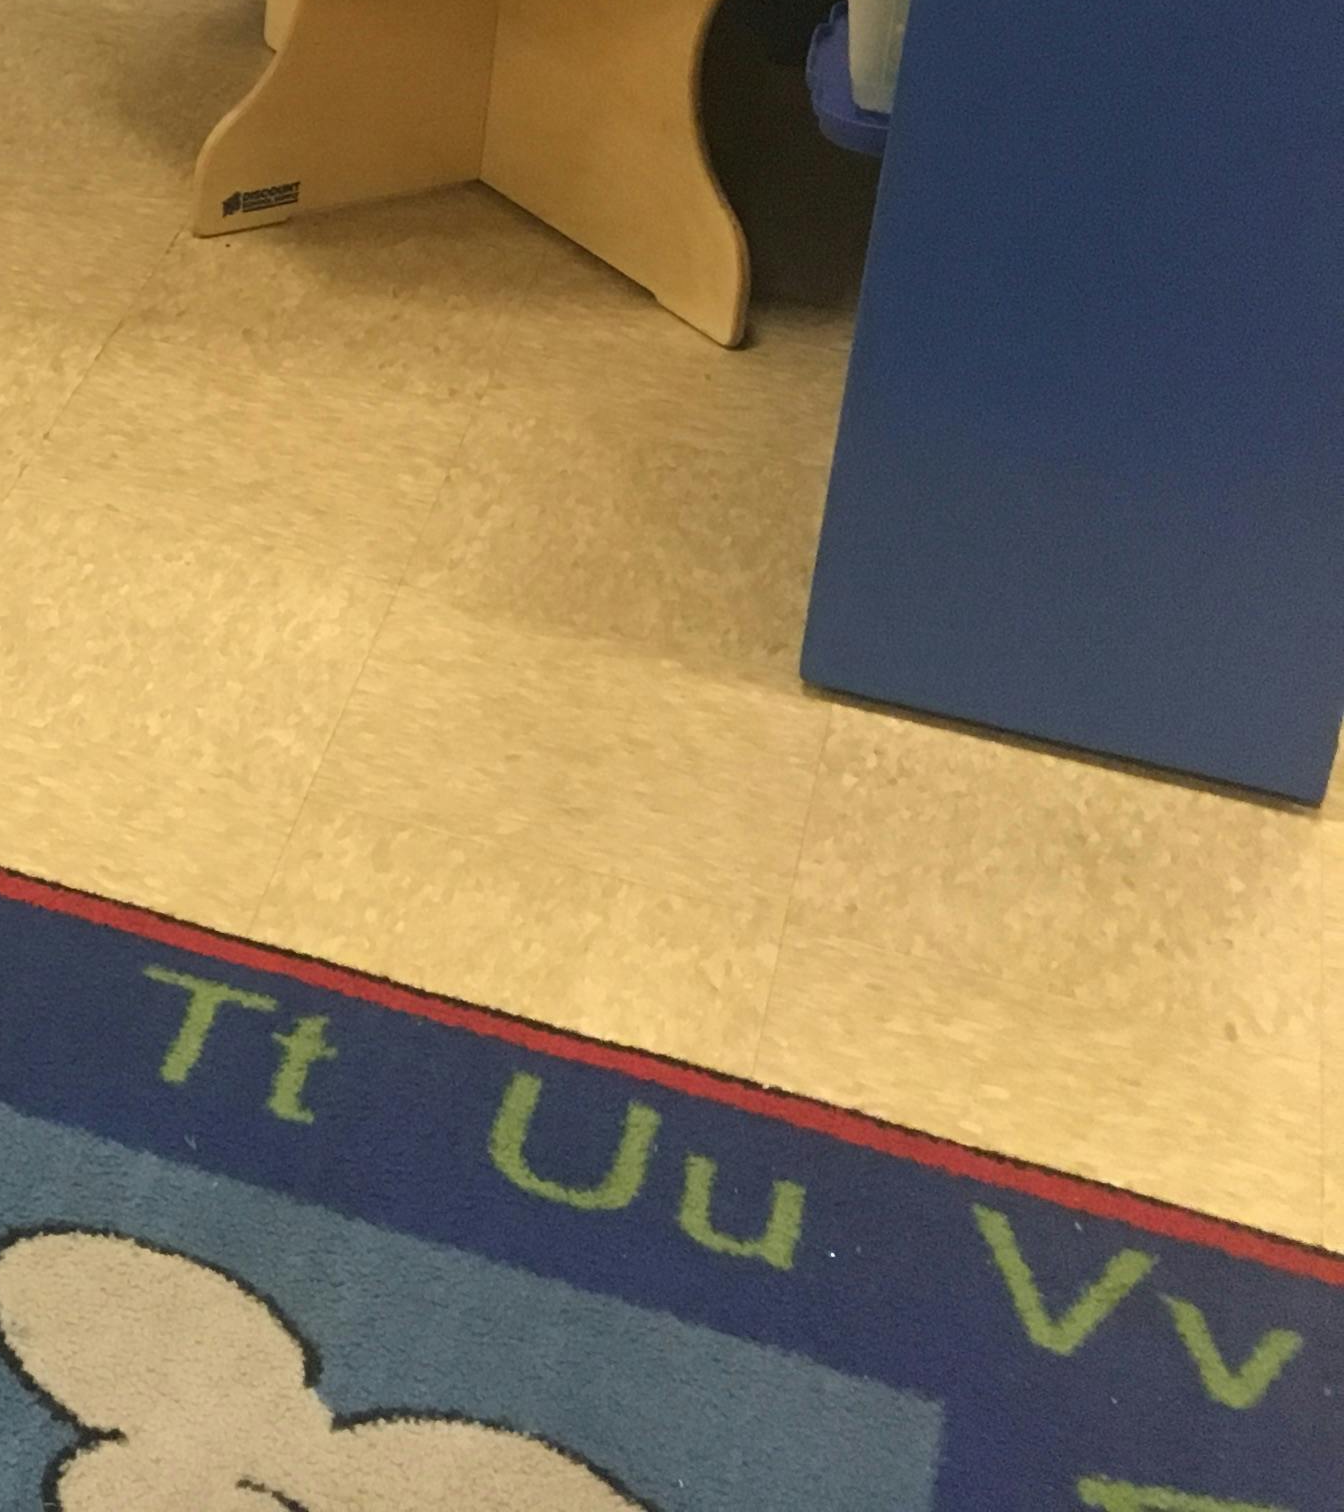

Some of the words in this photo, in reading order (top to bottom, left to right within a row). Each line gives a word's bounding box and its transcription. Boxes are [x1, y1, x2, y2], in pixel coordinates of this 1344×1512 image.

[141, 963, 342, 1126] Tt
[486, 1069, 807, 1271] Uu
[971, 1202, 1303, 1409] Vv
